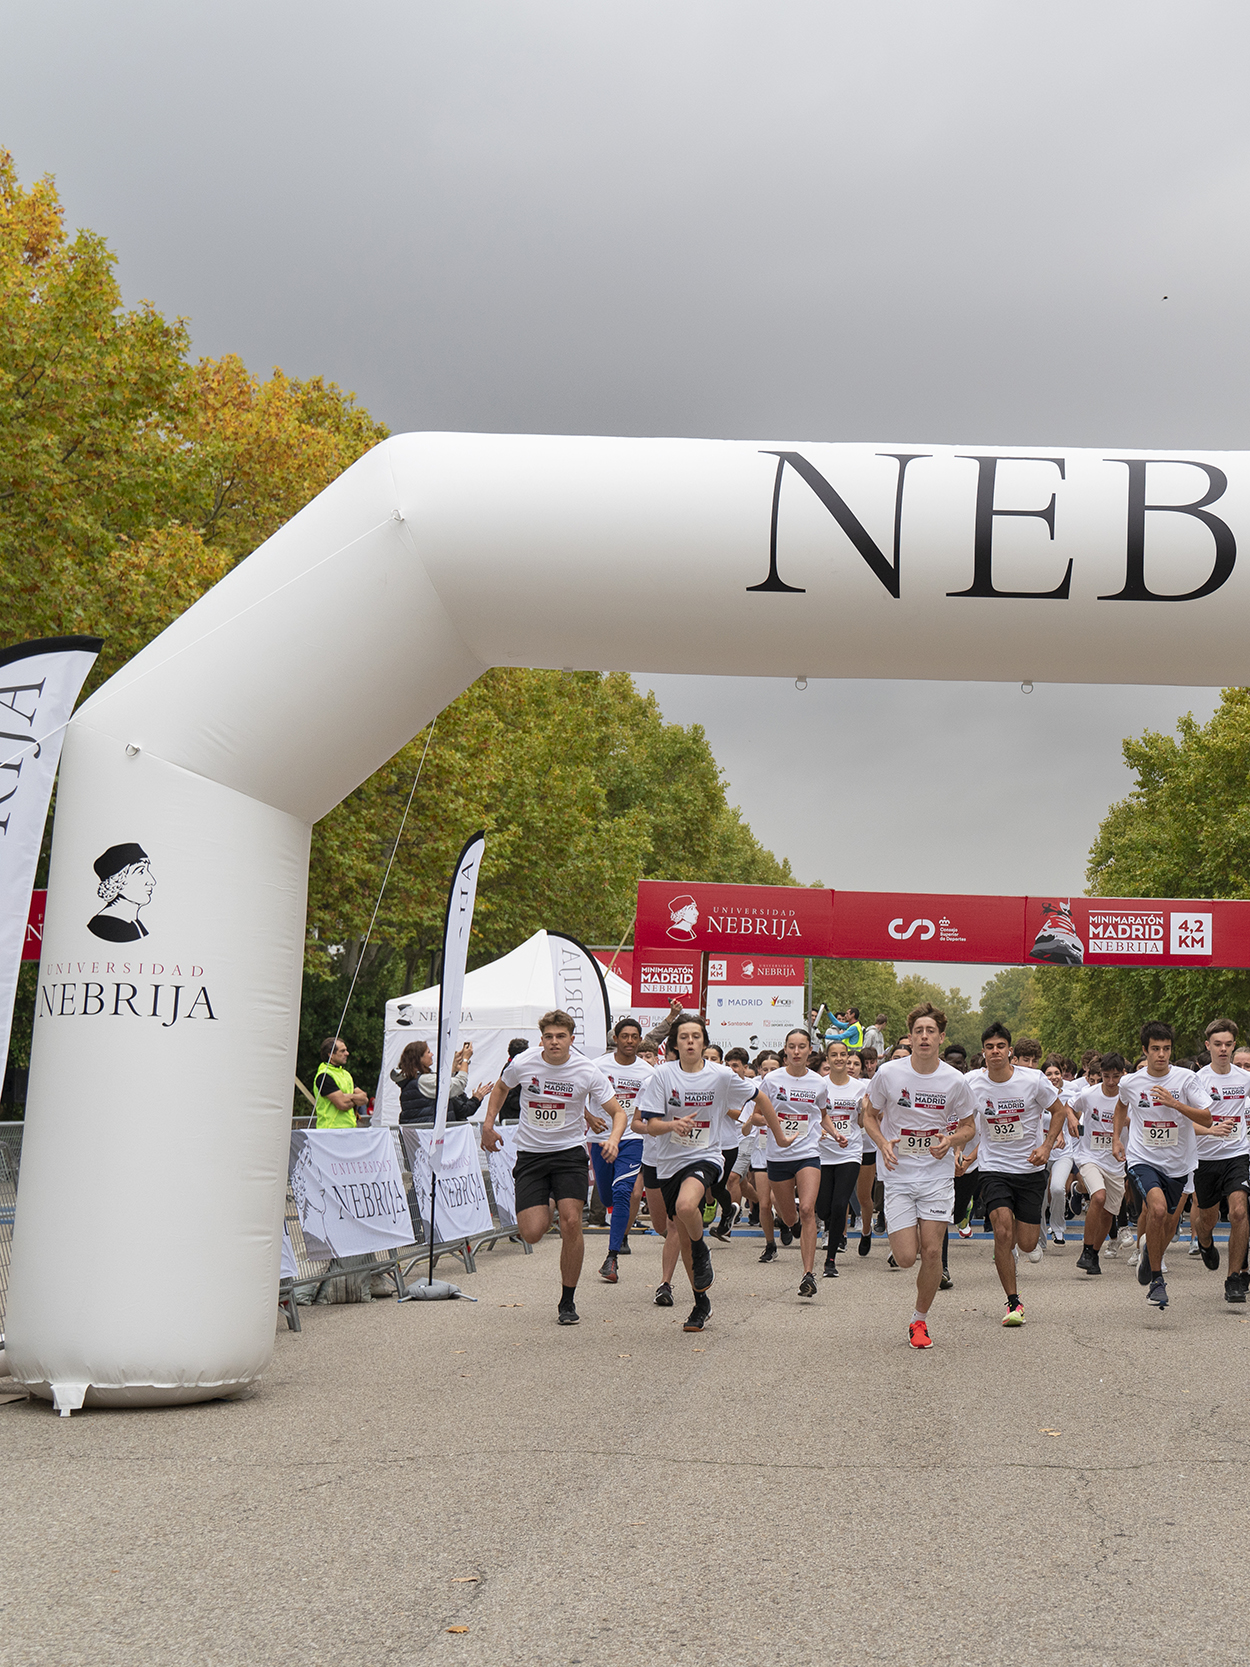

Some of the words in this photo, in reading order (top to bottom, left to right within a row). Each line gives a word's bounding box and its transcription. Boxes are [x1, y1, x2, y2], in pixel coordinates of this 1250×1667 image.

[713, 906, 796, 917] UNIVERSIDAD
[1089, 914, 1164, 924] MINIMARATÓN
[706, 915, 802, 940] NEBRIJA
[1089, 924, 1164, 939] MADRID
[1178, 920, 1204, 934] 4,2
[1178, 935, 1205, 948] KM
[1092, 941, 1160, 954] NEBRIJA
[47, 962, 204, 977] UNIVERSIDAD
[641, 966, 694, 974] MINIMARATÓN
[757, 968, 796, 978] NEBRIJA
[640, 974, 694, 984] MADRID
[643, 984, 690, 993] NEBRIJA
[39, 982, 219, 1028] NEBRIJA
[419, 1012, 474, 1024] NEJA
[544, 1084, 574, 1092] MADRID
[619, 1100, 631, 1108] 25
[535, 1110, 558, 1120] 900
[785, 1121, 798, 1130] 22
[994, 1124, 1016, 1134] 932
[687, 1129, 702, 1140] 47
[1150, 1128, 1170, 1139] 921
[908, 1136, 931, 1148] 918
[1094, 1136, 1112, 1144] 113
[438, 1172, 485, 1210] NEBRIJA
[332, 1180, 406, 1224] NEBRIJA
